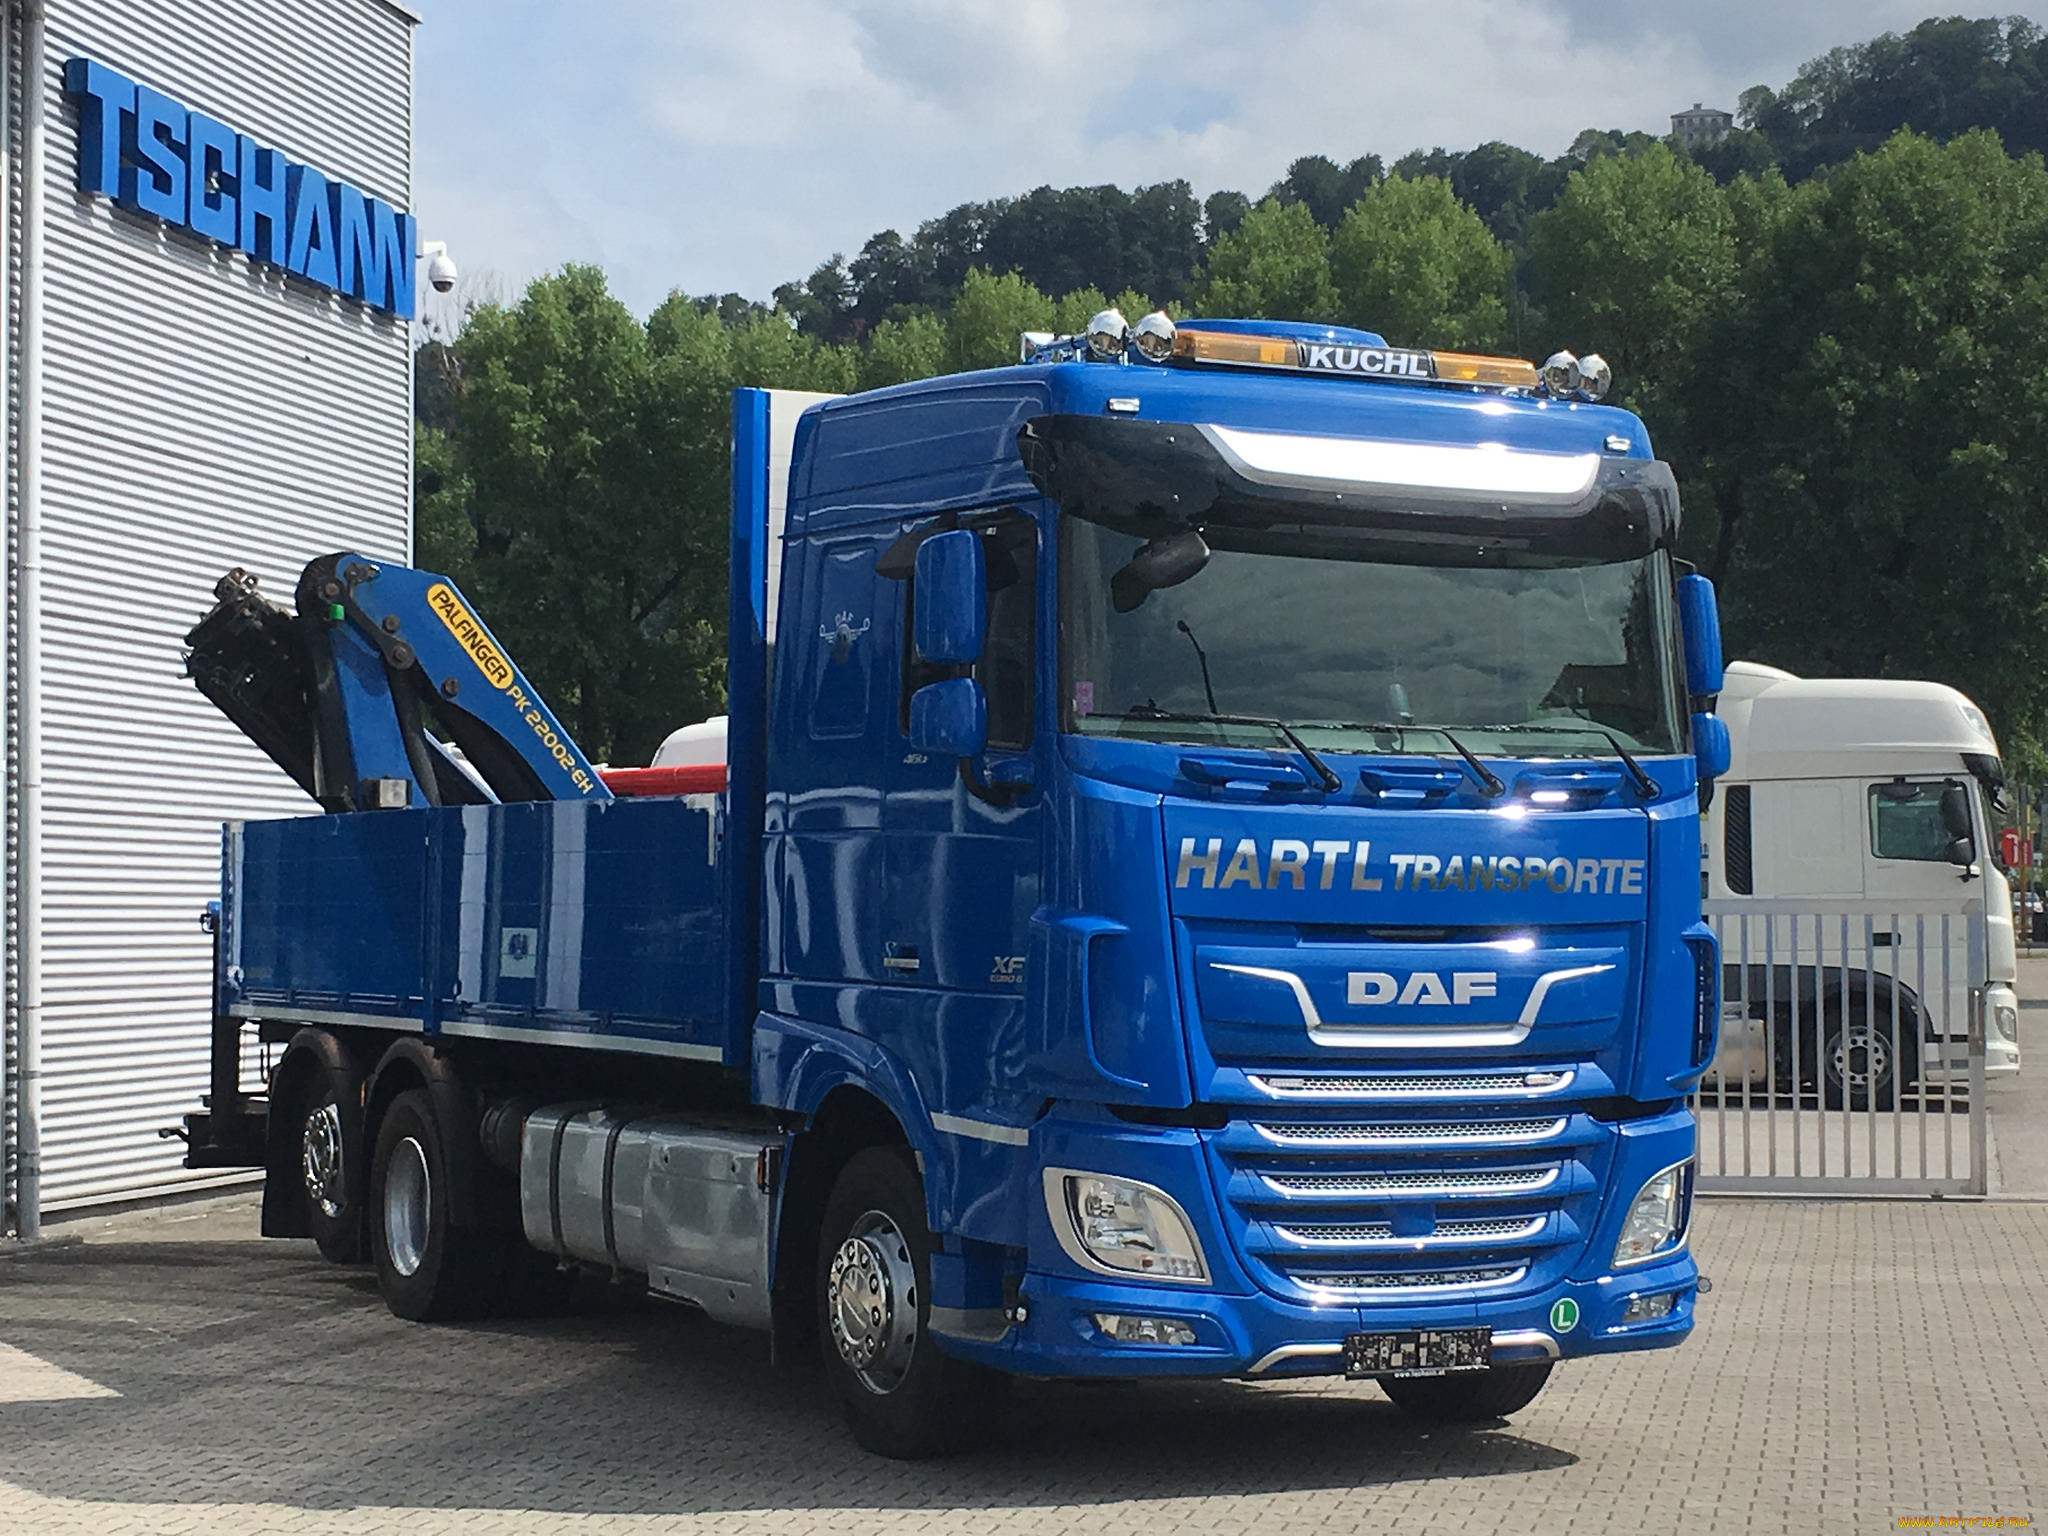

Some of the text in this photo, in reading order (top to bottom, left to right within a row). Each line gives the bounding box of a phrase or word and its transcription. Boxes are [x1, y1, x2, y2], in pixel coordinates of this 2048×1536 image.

[64, 57, 416, 321] TSCHANN
[1309, 346, 1428, 377] KUCHL
[432, 590, 508, 684] PALFINGER
[506, 685, 532, 713] PK
[1175, 837, 1645, 895] HARTL TRANSPORTE
[991, 956, 1026, 973] XF
[1347, 971, 1497, 1005] DAF
[1558, 1304, 1572, 1327] L
